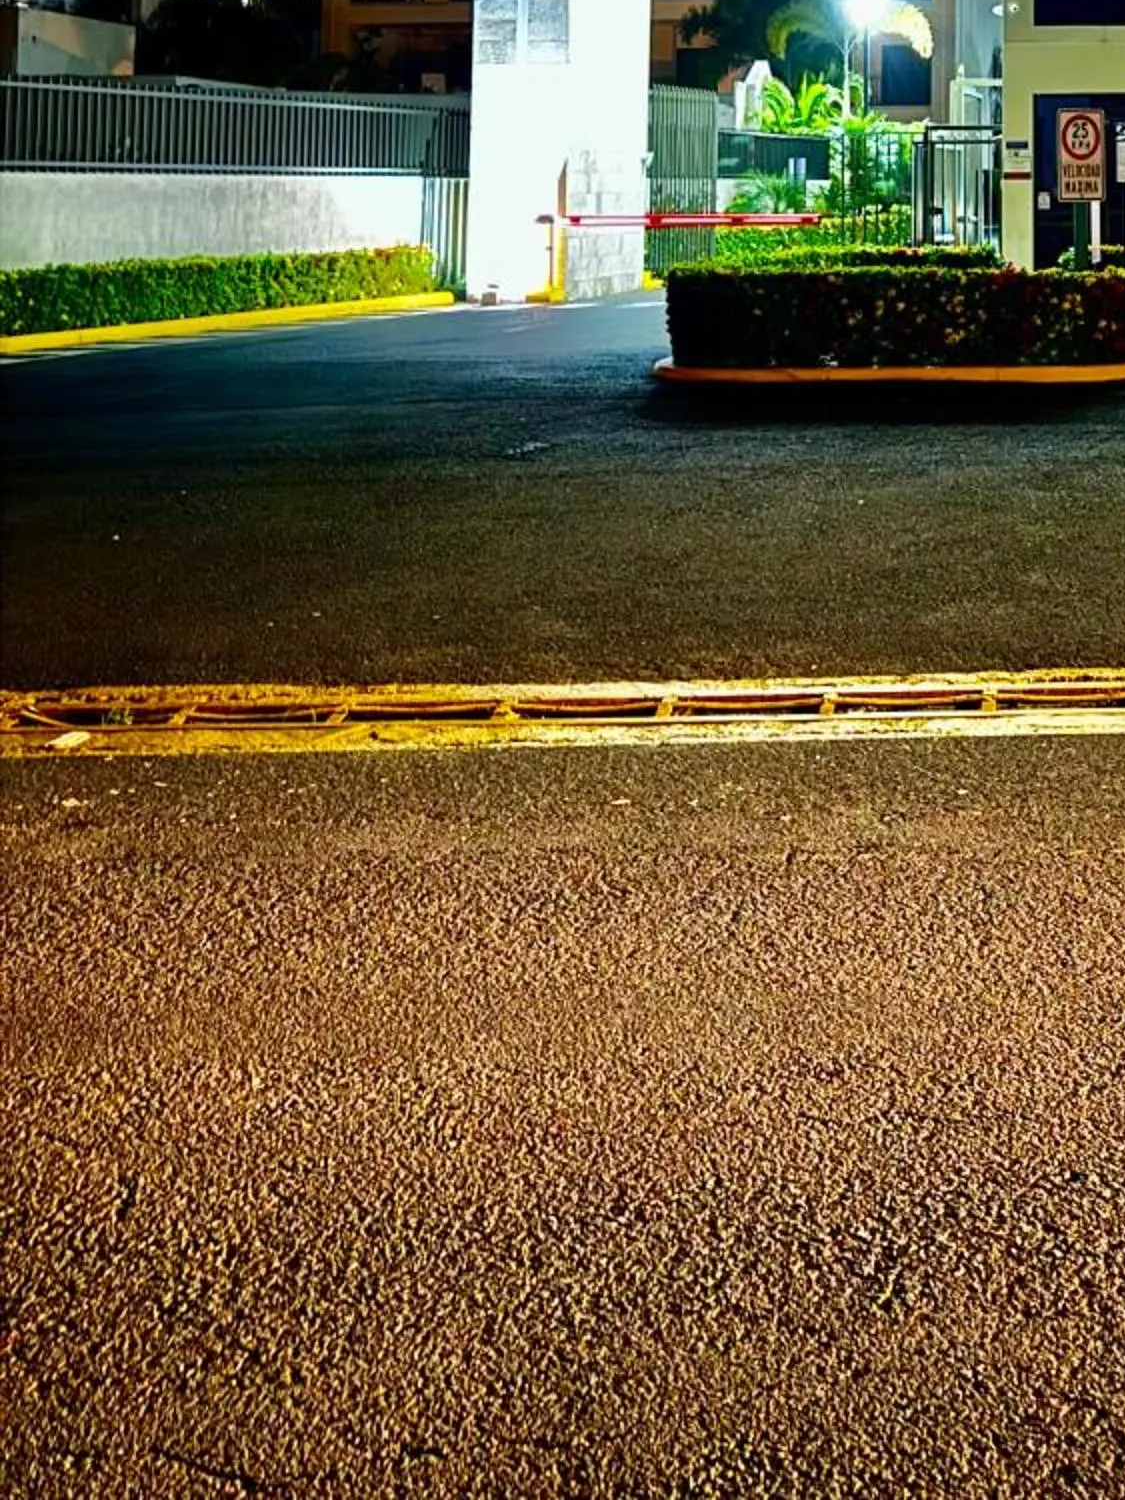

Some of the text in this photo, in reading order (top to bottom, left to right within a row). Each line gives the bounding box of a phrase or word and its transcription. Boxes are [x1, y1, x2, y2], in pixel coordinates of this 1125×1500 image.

[1071, 121, 1089, 139] 25
[1063, 164, 1101, 178] VELOCIDAD
[1065, 180, 1099, 193] MAXIMA
